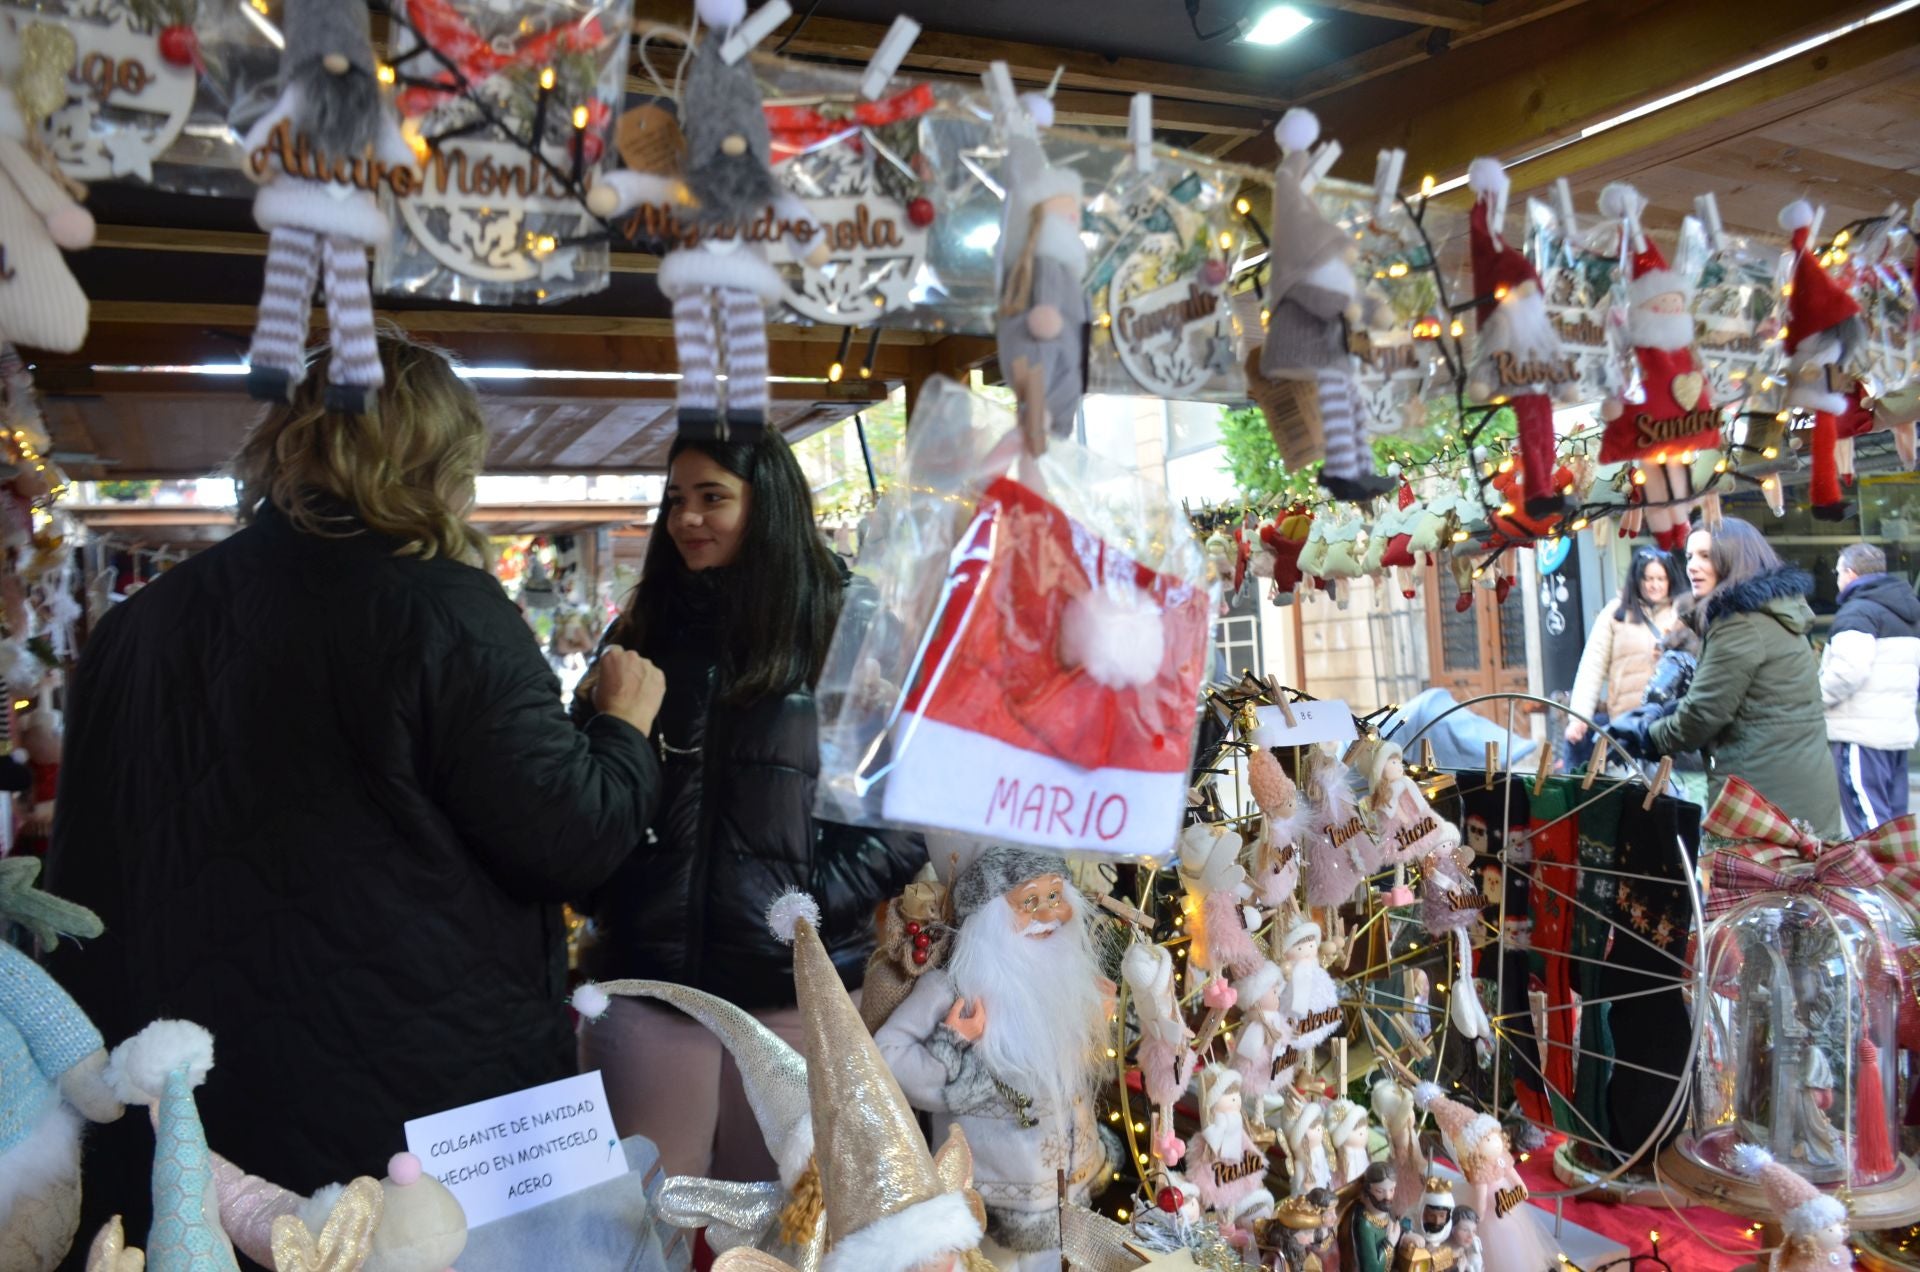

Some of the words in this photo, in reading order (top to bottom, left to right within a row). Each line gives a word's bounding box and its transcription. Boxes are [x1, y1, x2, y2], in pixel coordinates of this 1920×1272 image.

[1637, 408, 1726, 447] Sandra
[985, 776, 1128, 840] MARIO
[430, 1123, 508, 1158] COLGANTE
[510, 1116, 531, 1135] DE
[532, 1099, 595, 1129] NAVIDAD
[437, 1161, 490, 1187] HECHO
[493, 1153, 515, 1172] EN
[517, 1127, 599, 1165] MONTECELO
[1211, 1150, 1265, 1187] Paula
[507, 1173, 553, 1200] ACERO
